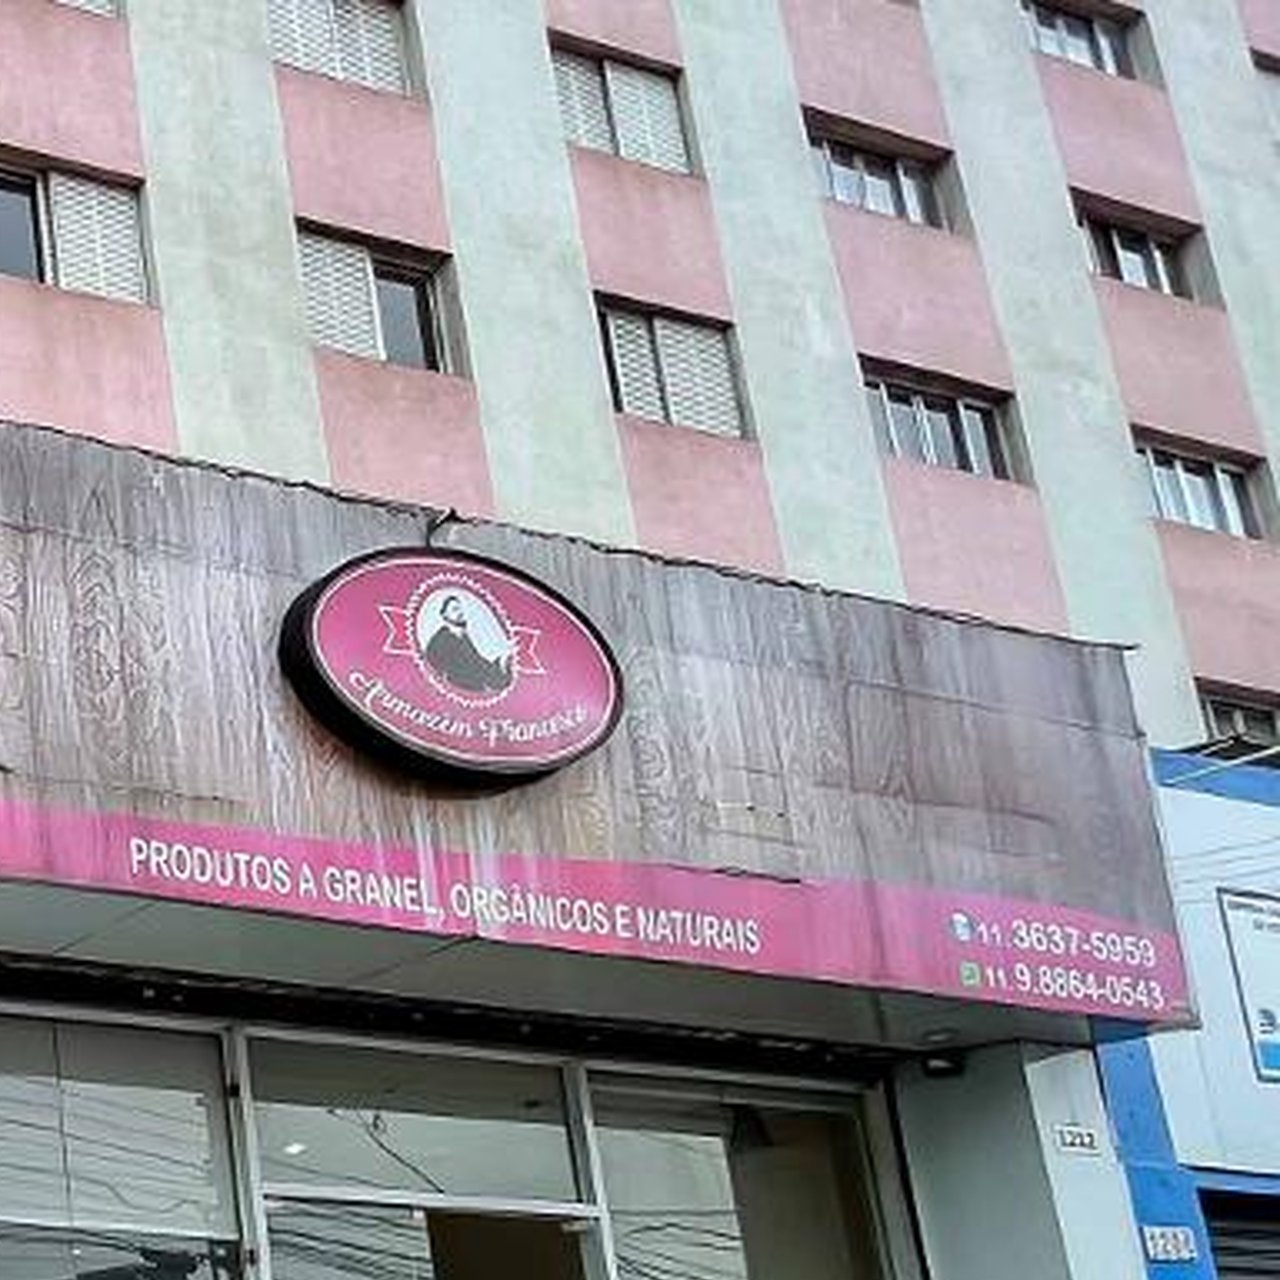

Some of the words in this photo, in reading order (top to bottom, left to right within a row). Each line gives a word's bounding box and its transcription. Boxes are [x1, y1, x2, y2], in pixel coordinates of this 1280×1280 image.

[129, 838, 291, 894] PRODUTOS
[298, 863, 317, 898] A
[324, 867, 445, 920] GRANEL,
[450, 882, 610, 936] ORGÂNICOS
[615, 904, 637, 939] E
[637, 907, 761, 955] NATURAIS
[1011, 919, 1157, 967] 3637-5959
[1014, 963, 1166, 1010] 9.8864-0543
